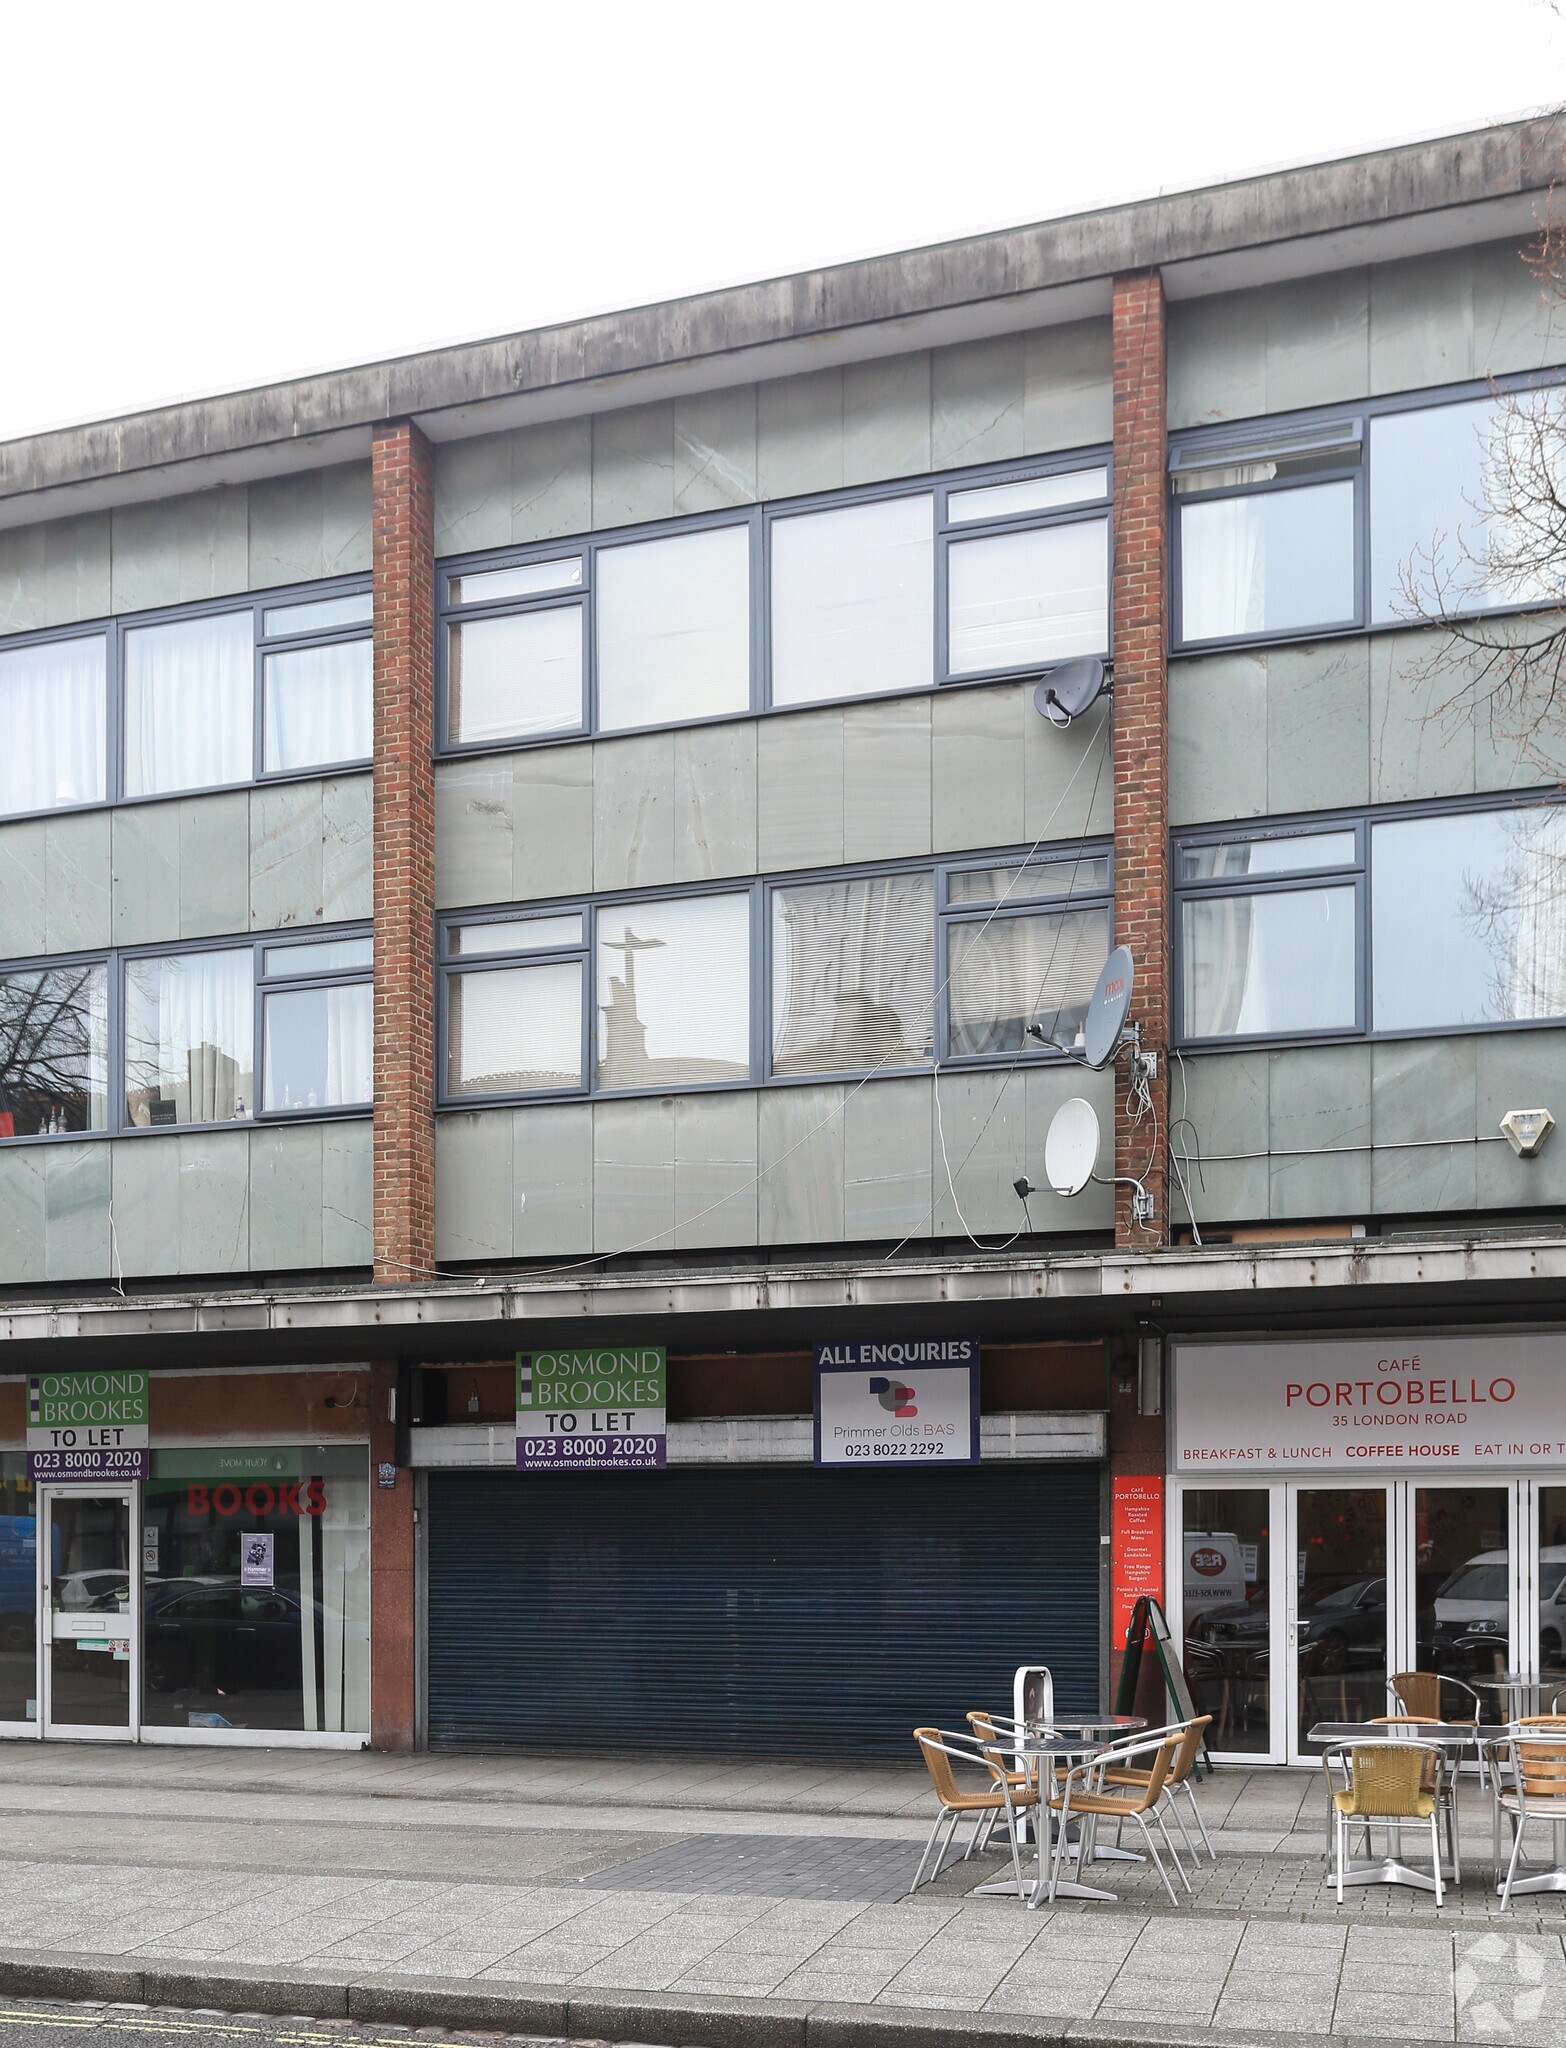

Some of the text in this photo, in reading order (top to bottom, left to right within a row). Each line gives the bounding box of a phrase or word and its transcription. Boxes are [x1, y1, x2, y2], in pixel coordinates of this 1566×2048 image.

[819, 1341, 972, 1365] ALL ENQUIRIES
[535, 1351, 661, 1377] OSMOND
[1377, 1355, 1421, 1372] CAFÉ
[42, 1374, 144, 1397] OSMOND
[538, 1379, 660, 1404] BROOKES
[1286, 1377, 1516, 1408] PORTOBELLO
[44, 1398, 143, 1421] BROOKES
[545, 1412, 635, 1433] TO LET
[1332, 1412, 1468, 1427] 35 LONDON ROAD
[50, 1428, 124, 1447] TO LET
[834, 1425, 887, 1438] Primmer
[890, 1424, 920, 1437] Olds
[524, 1437, 657, 1456] 023 8000 2020
[845, 1442, 944, 1457] 023 8022 2292
[1183, 1447, 1332, 1460] BREAKFAST & LUNCH
[1345, 1444, 1460, 1457] COFFEE HOUSE
[1474, 1444, 1502, 1455] EAT
[1508, 1443, 1524, 1455] IN
[1529, 1443, 1551, 1454] OR
[34, 1451, 142, 1468] 023 8000 2020
[525, 1457, 657, 1468] www.osmondbrookes.co.uk
[33, 1468, 142, 1479] www.osmondbrookes.co.uk
[187, 1480, 327, 1517] BOOKS
